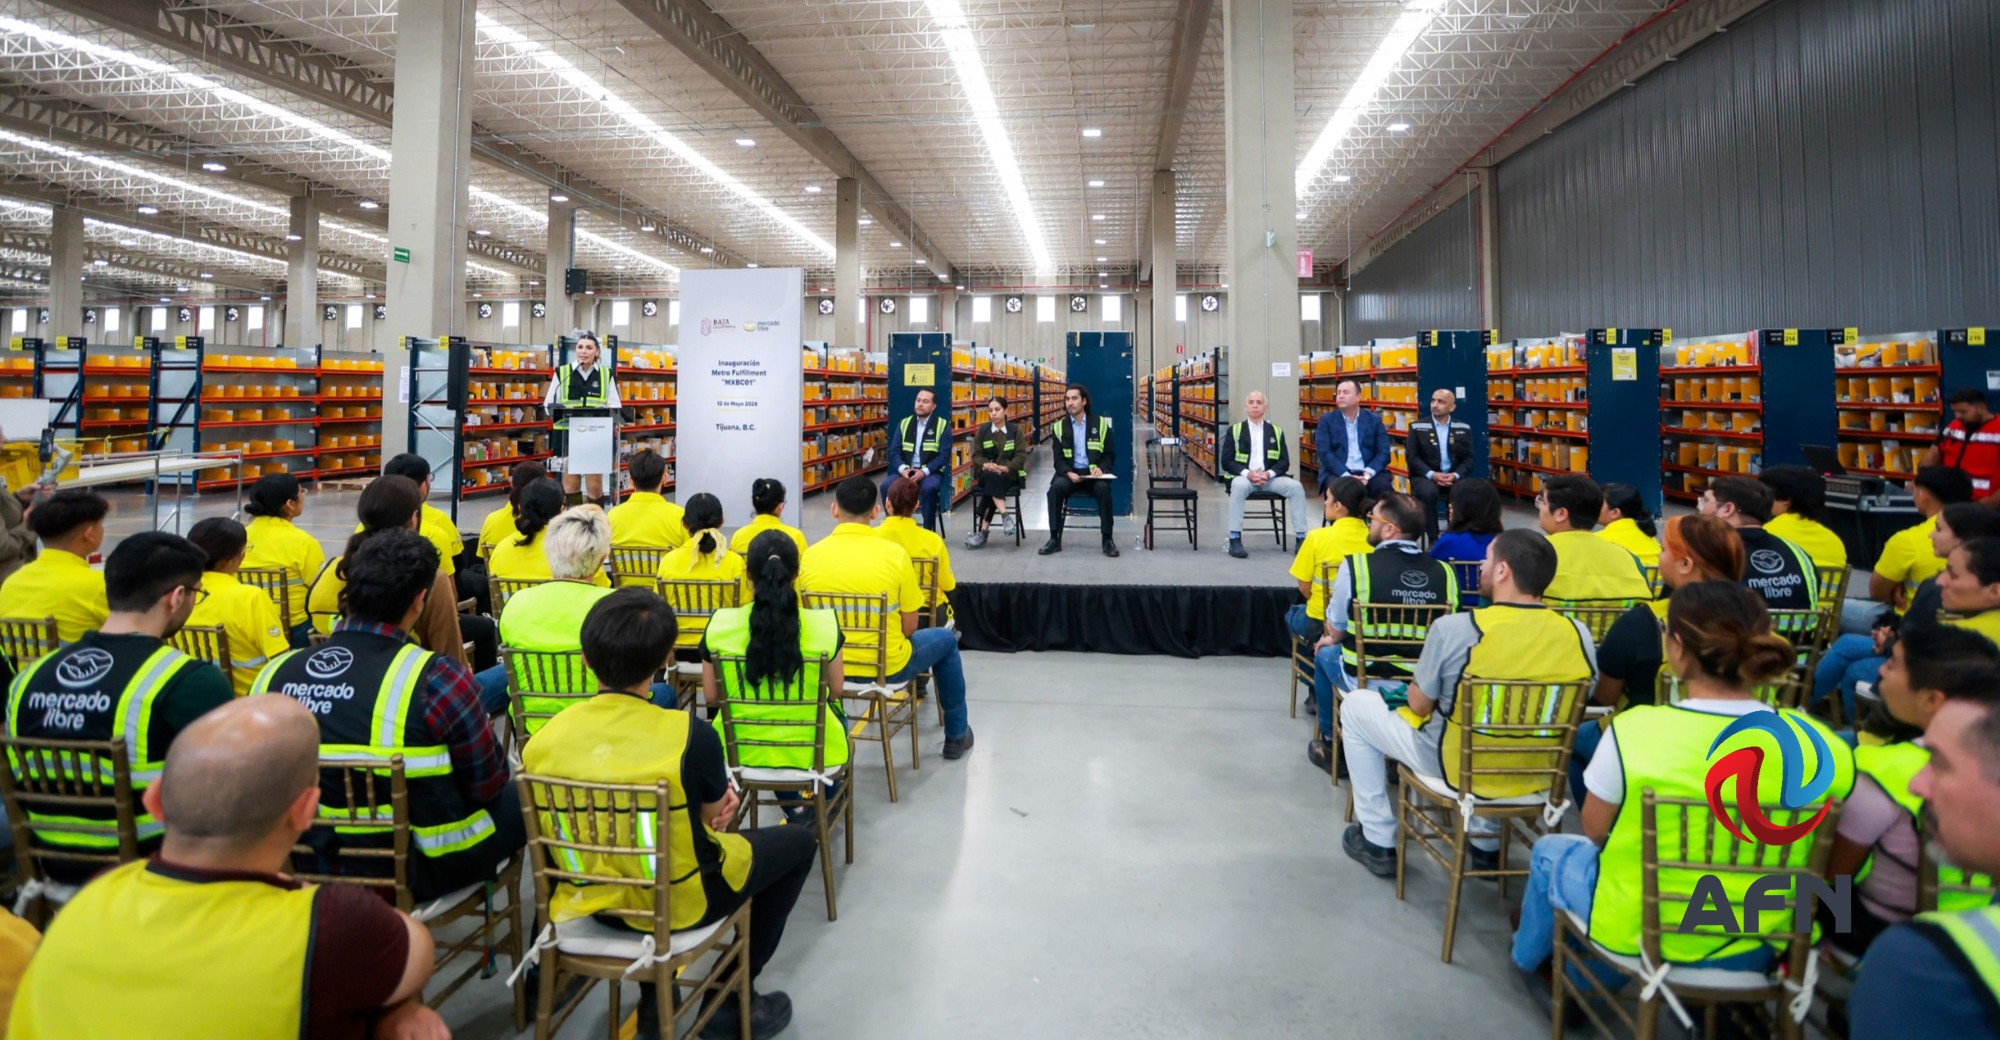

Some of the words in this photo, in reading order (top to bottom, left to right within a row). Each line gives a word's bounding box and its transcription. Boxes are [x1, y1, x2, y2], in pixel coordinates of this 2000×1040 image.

[718, 360, 760, 368] Inauguración
[732, 369, 767, 377] Fulfillment
[716, 423, 741, 431] Tijuana,
[1748, 573, 1801, 589] mercado
[1391, 589, 1437, 600] mercado
[1764, 586, 1793, 599] libre
[1402, 597, 1426, 605] libre
[281, 682, 355, 700] mercado
[28, 690, 112, 712] mercado
[43, 708, 85, 731] libre
